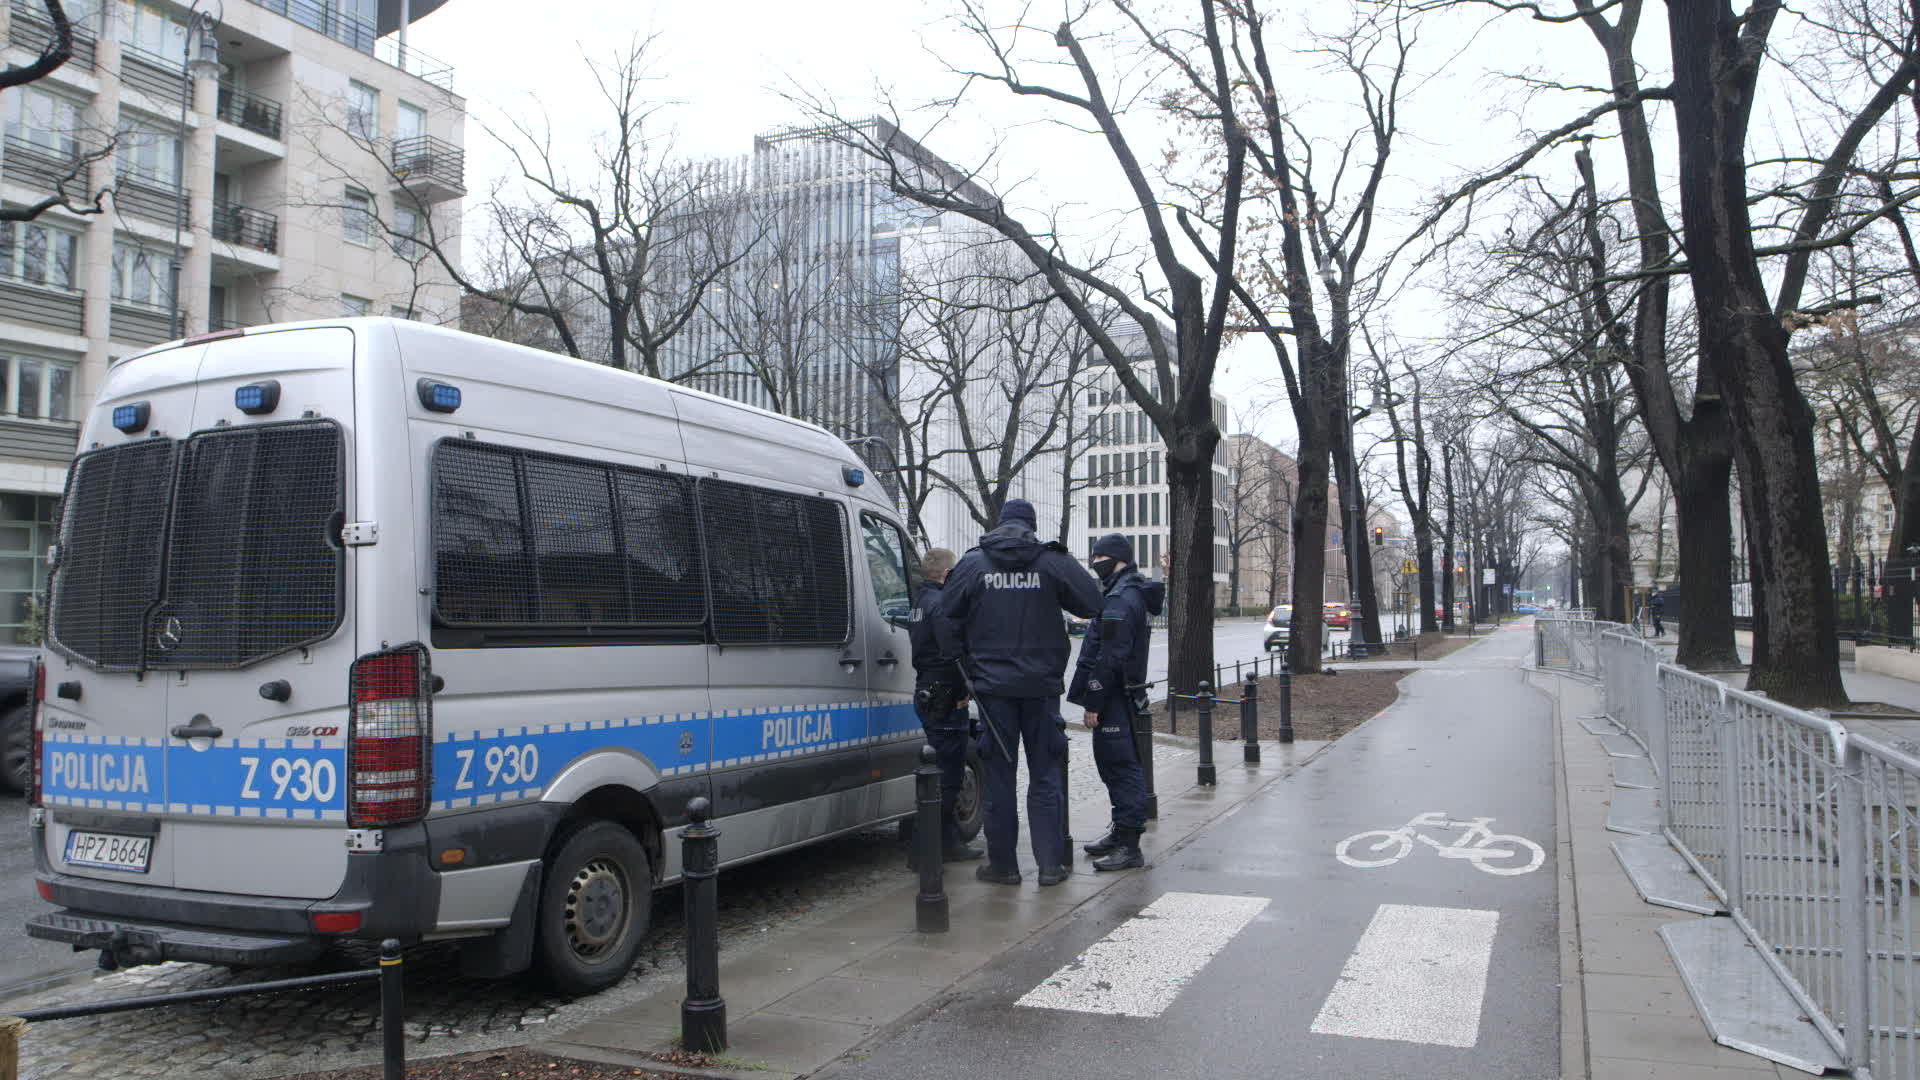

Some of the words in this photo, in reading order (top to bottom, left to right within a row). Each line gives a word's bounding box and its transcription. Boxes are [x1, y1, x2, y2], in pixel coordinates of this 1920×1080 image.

[984, 572, 1041, 590] POLICJA
[762, 712, 833, 750] POLICJA
[50, 751, 150, 793] POLICJA
[240, 757, 260, 799] Z
[271, 757, 337, 803] 930
[455, 749, 475, 791] Z
[484, 743, 539, 787] 930
[74, 833, 108, 861] HPZ
[109, 838, 149, 865] B664
